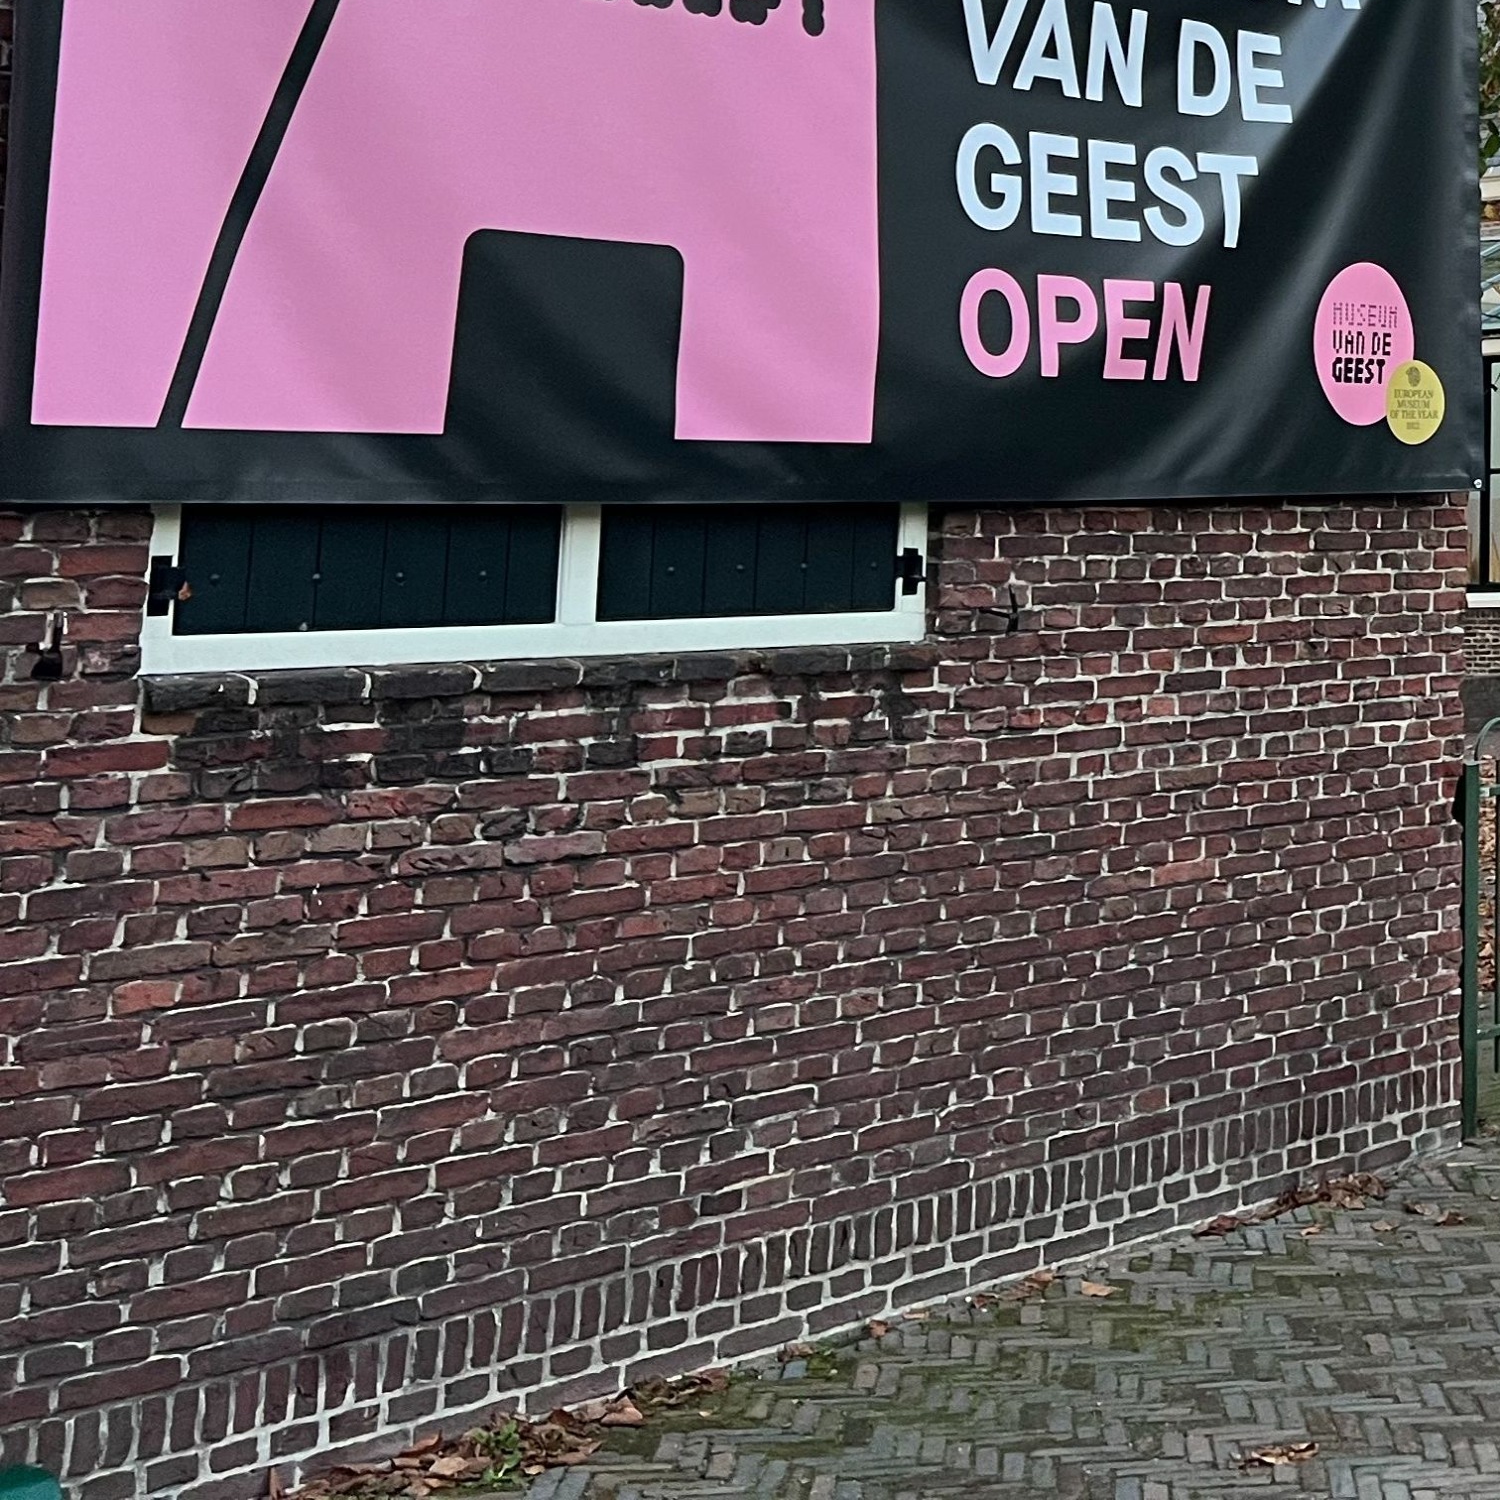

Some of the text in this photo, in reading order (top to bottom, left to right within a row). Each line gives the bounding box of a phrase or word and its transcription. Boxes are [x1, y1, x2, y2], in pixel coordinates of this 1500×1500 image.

[1177, 18, 1293, 124] DE
[956, 123, 1259, 248] GEEST
[959, 268, 1212, 382] OPEN
[1333, 302, 1398, 328] MUSEUM
[1332, 329, 1391, 355] VAN DE
[1332, 357, 1386, 384] GEEST
[1394, 389, 1433, 398] EUROPEAN
[1397, 400, 1430, 408] MUSEUM
[1390, 410, 1438, 419] OF THE YEAR
